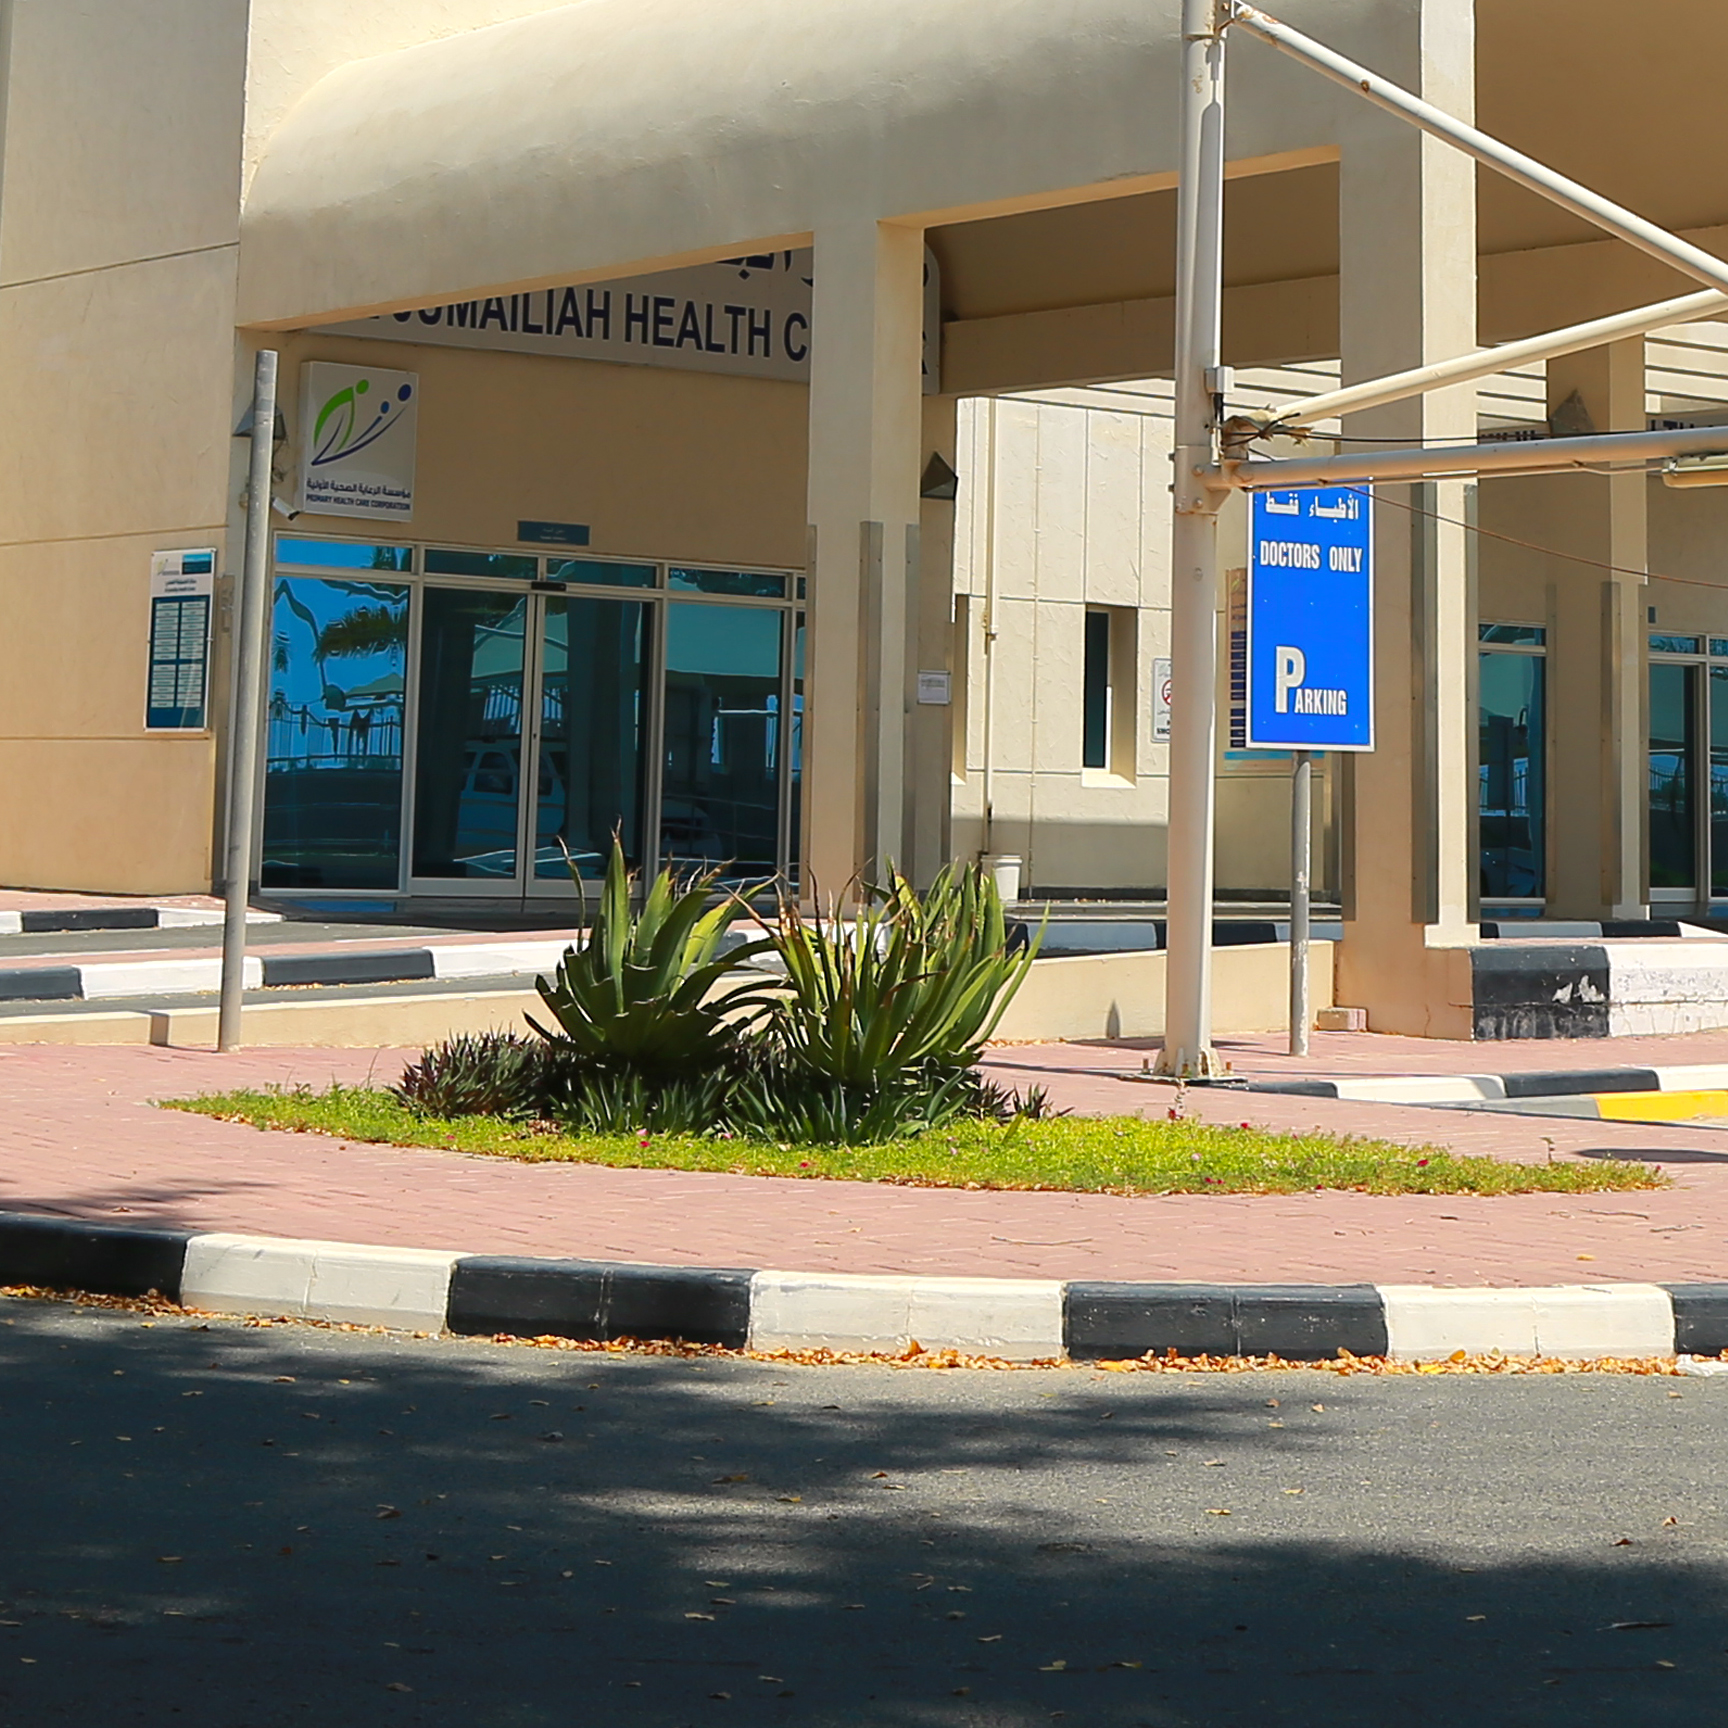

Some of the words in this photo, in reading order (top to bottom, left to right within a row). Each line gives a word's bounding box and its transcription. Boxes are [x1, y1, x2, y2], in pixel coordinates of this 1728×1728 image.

[625, 293, 771, 358] HEALTH
[1265, 491, 1300, 516] فقط
[1260, 540, 1321, 569] DOCTORS
[1329, 545, 1363, 573] ONLY
[1275, 645, 1347, 715] PARKING
